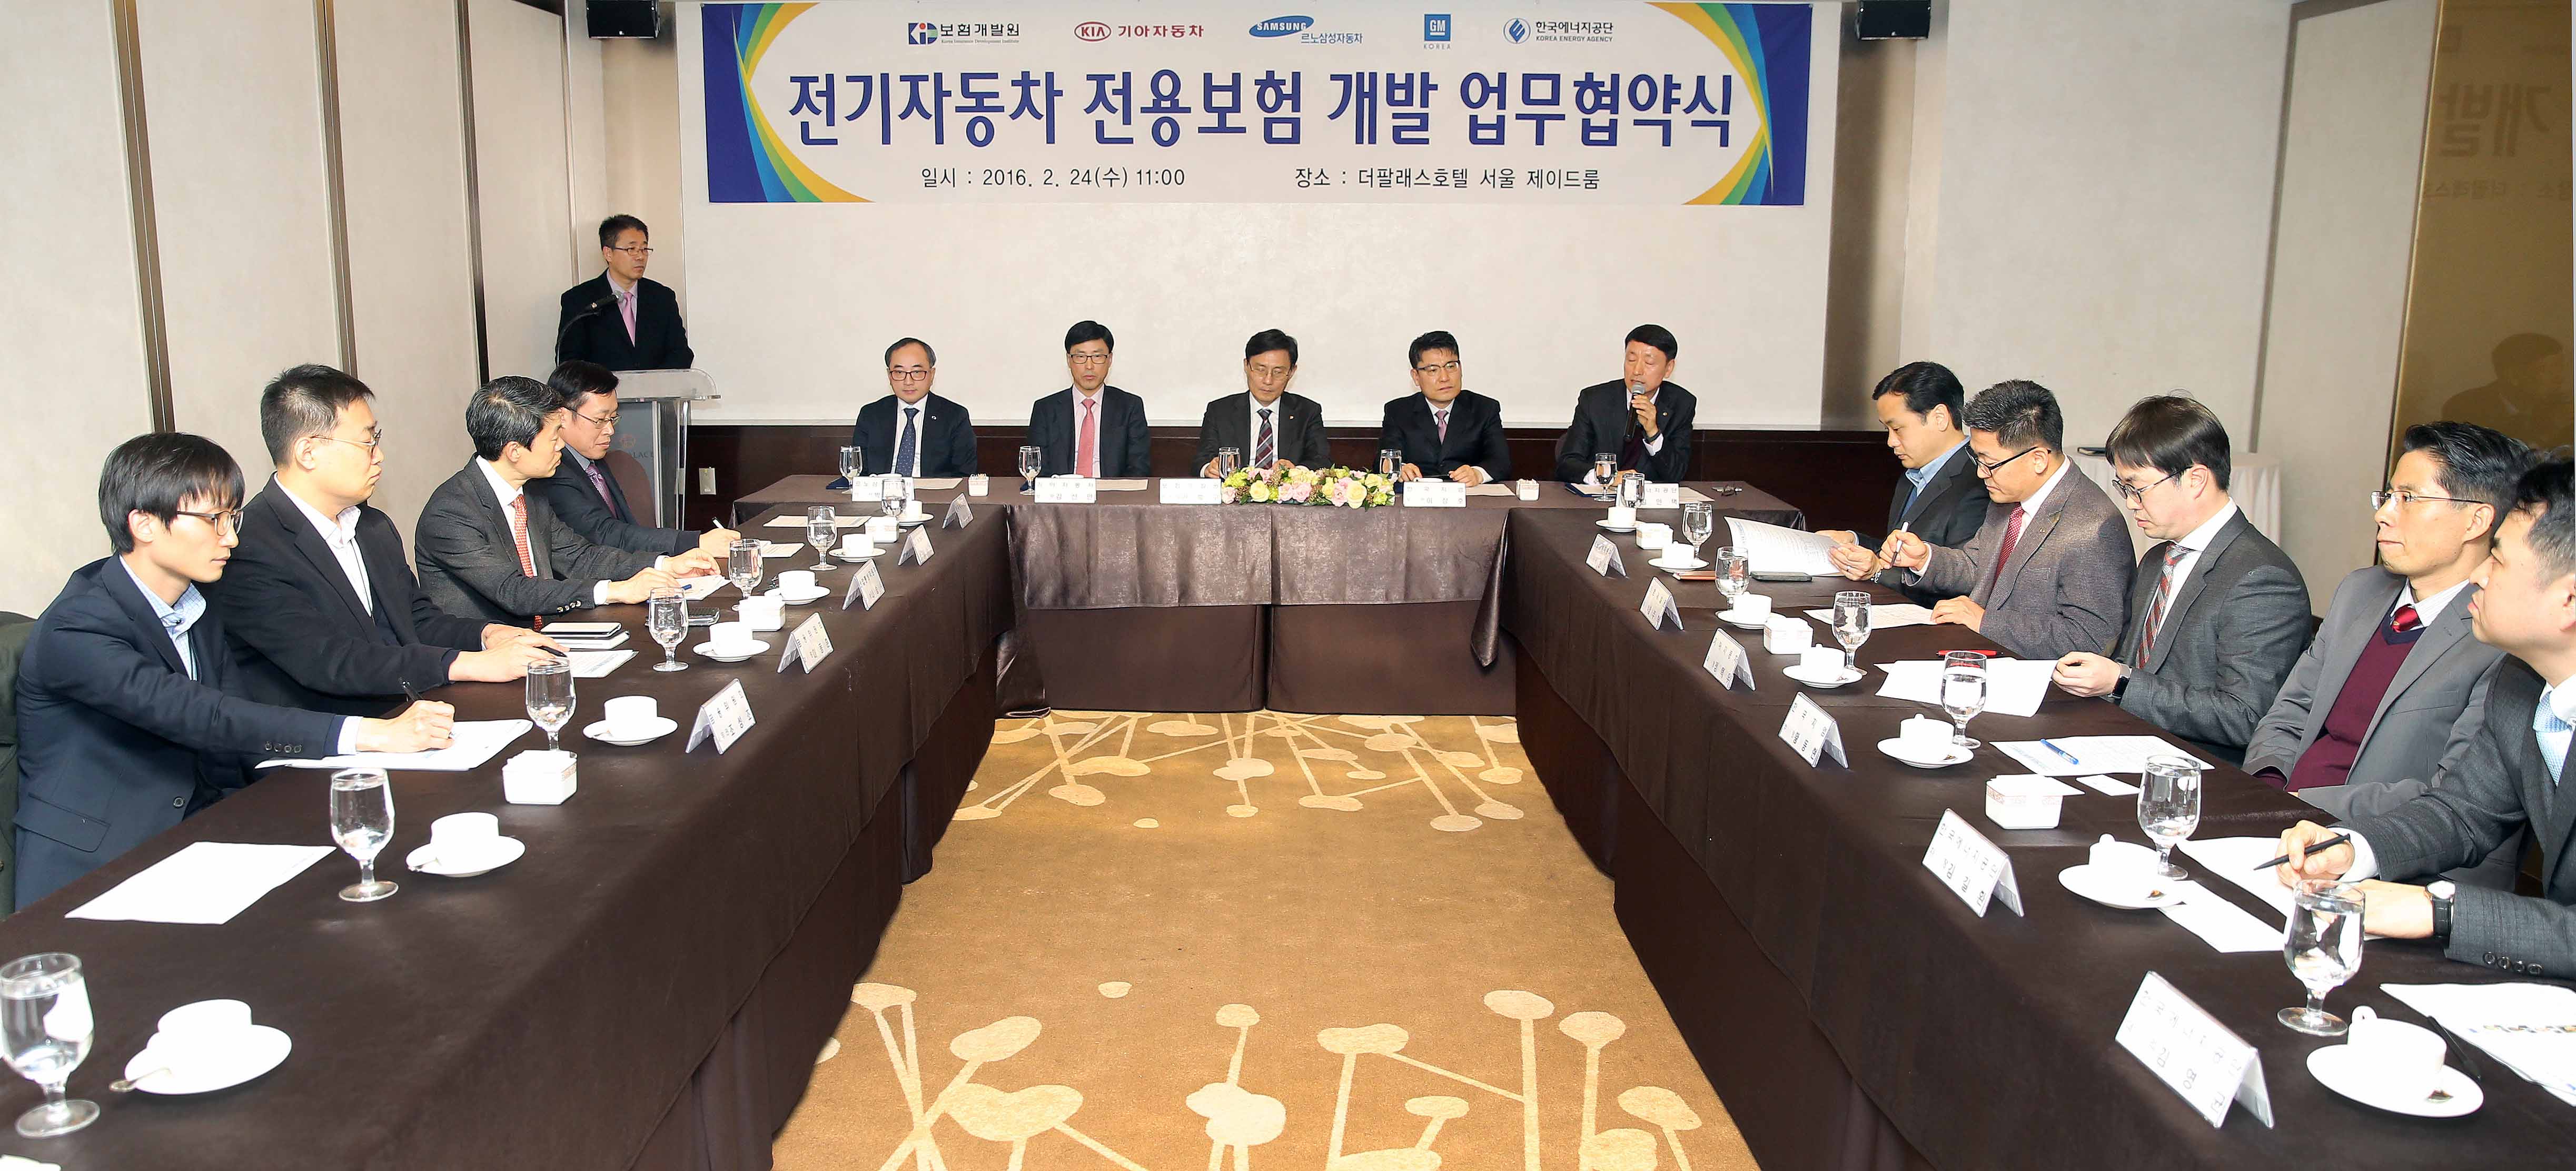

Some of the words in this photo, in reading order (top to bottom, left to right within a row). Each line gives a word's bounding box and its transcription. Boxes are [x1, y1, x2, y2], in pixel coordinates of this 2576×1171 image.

[940, 23, 1020, 37] 보험개발원
[1080, 26, 1105, 37] KIA
[1118, 24, 1204, 38] 기아자동차
[1256, 22, 1306, 31] SAMSUNG
[1430, 19, 1445, 32] GM
[1535, 21, 1613, 34] 한국에너지공단
[1301, 33, 1363, 44] 르노삼성자동차
[789, 70, 1064, 147] 전기자동차
[1083, 70, 1302, 147] 전용보험
[1327, 70, 1439, 146] 개발
[1460, 71, 1732, 148] 업무협약식
[922, 167, 955, 188] 일시
[983, 168, 1032, 187] 2016.
[1043, 168, 1059, 187] 2.
[1070, 166, 1127, 188] 24(수)
[1136, 168, 1185, 186] 11:00
[1295, 167, 1331, 188] 장소
[1359, 167, 1468, 189] 더팔래스호텔
[1479, 168, 1516, 189] 서울
[1526, 168, 1600, 190] 제이드룸
